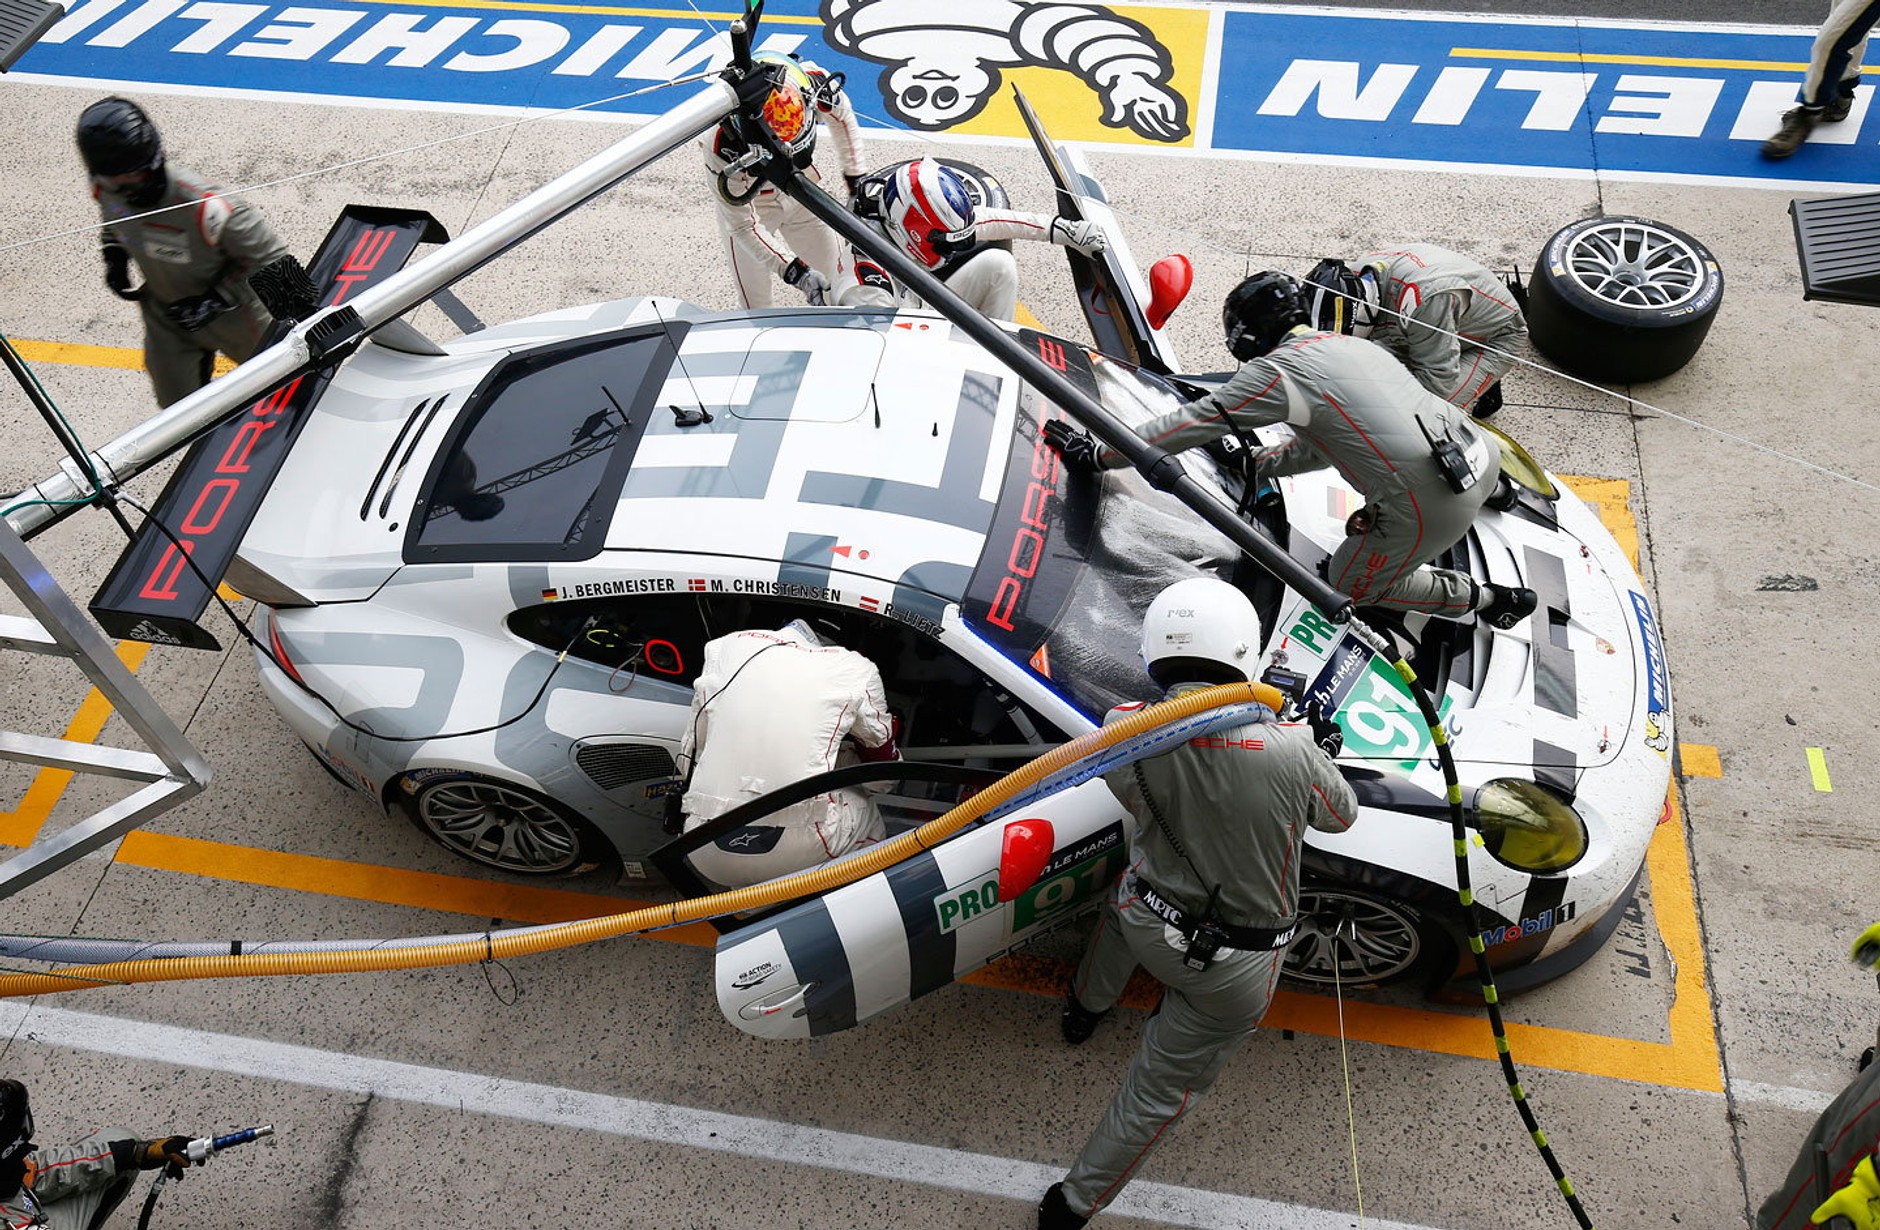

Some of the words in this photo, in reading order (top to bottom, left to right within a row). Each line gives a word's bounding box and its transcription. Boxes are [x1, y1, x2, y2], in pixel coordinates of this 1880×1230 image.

[1257, 58, 1880, 146] HELIN
[562, 586, 573, 599] J.
[575, 578, 676, 598] BERGMEISTER
[710, 579, 729, 592] M.
[733, 579, 841, 602] CHRISTENSEN
[883, 603, 899, 619] R.
[902, 610, 947, 640] LIETZ
[1289, 602, 1338, 655] PR
[1326, 675, 1341, 695] LE
[1339, 644, 1364, 682] MANS
[1634, 593, 1665, 707] MICHELIN
[1346, 670, 1423, 763] 91
[1053, 854, 1072, 869] LE
[1074, 831, 1118, 860] MANS
[938, 879, 999, 930] PRO
[1482, 908, 1553, 947] Mobil
[748, 960, 772, 976] ACTION
